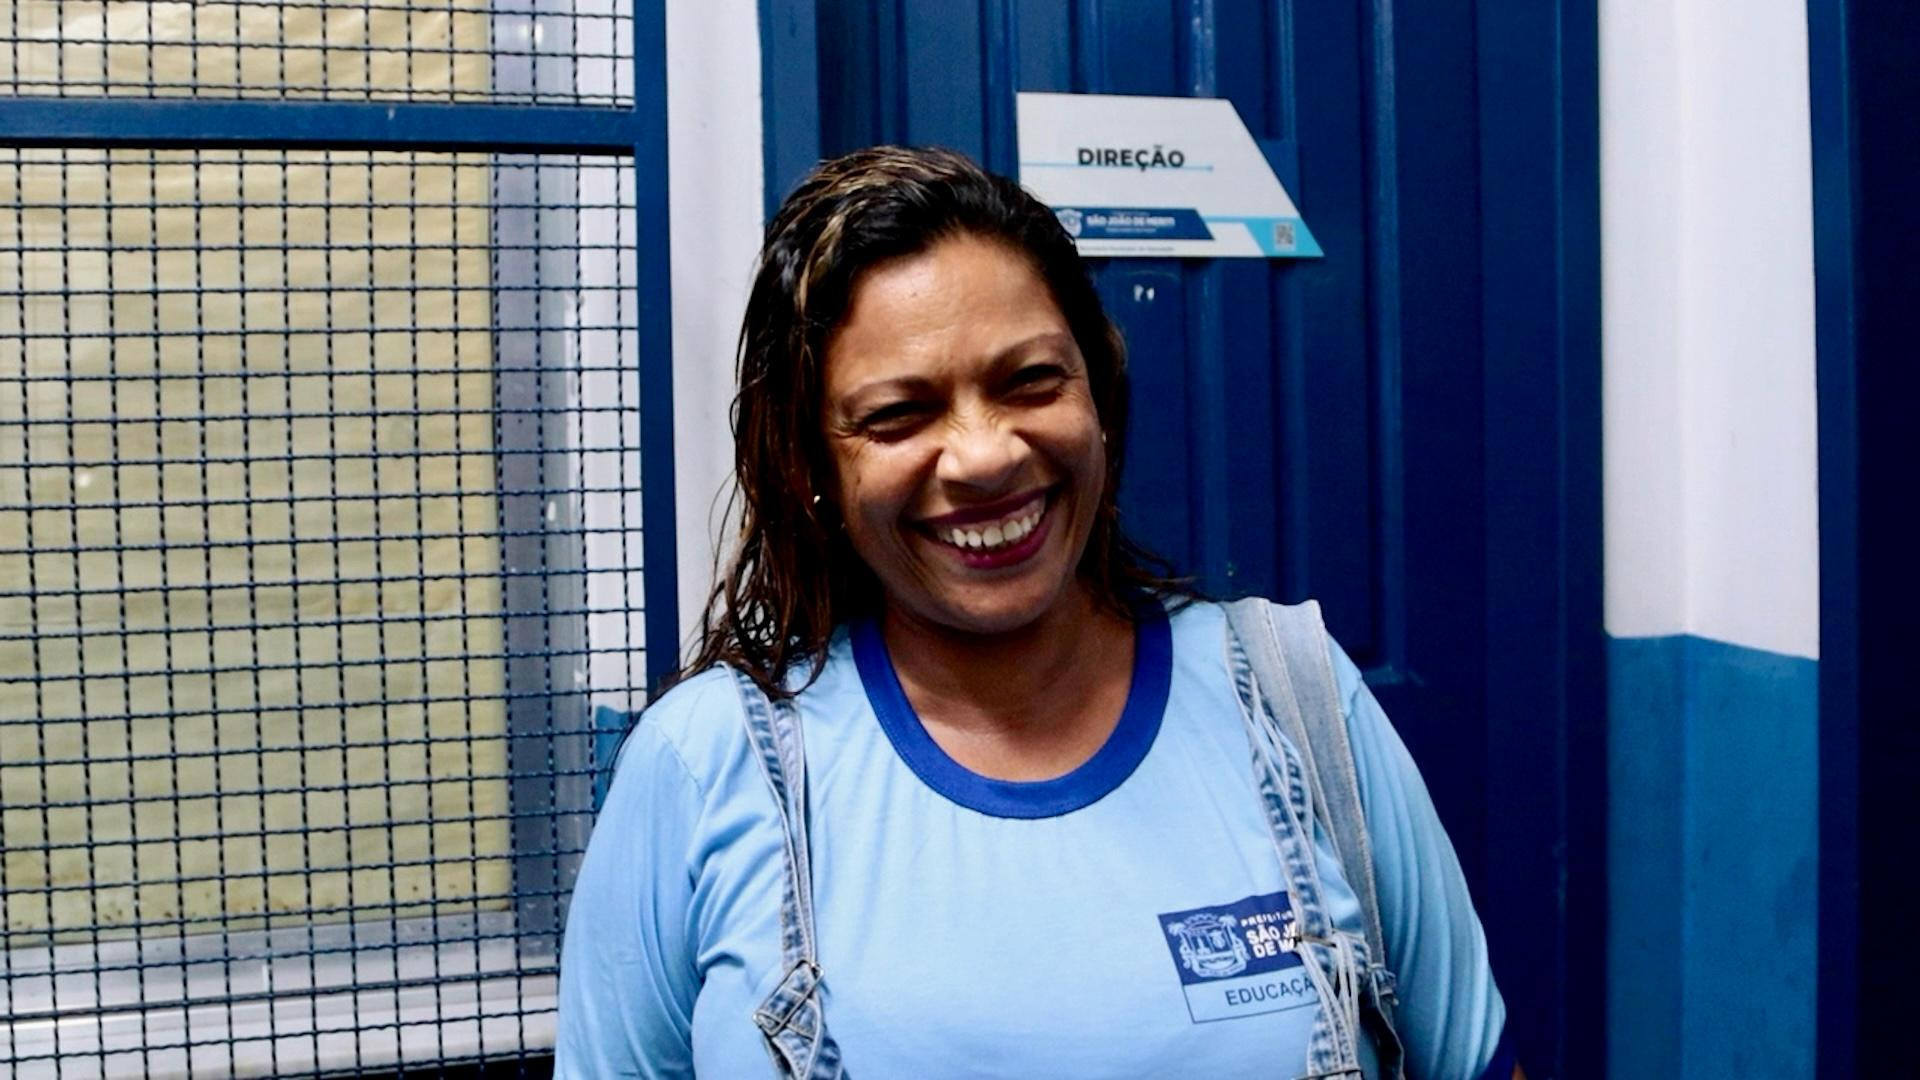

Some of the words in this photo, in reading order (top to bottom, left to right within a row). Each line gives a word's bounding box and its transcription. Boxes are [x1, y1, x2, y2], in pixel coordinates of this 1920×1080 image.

[1077, 145, 1185, 172] DIREÇÃO
[1246, 924, 1281, 945] SÃO
[1253, 942, 1278, 959] DE
[1225, 973, 1316, 1006] EDUCAÇÃ
